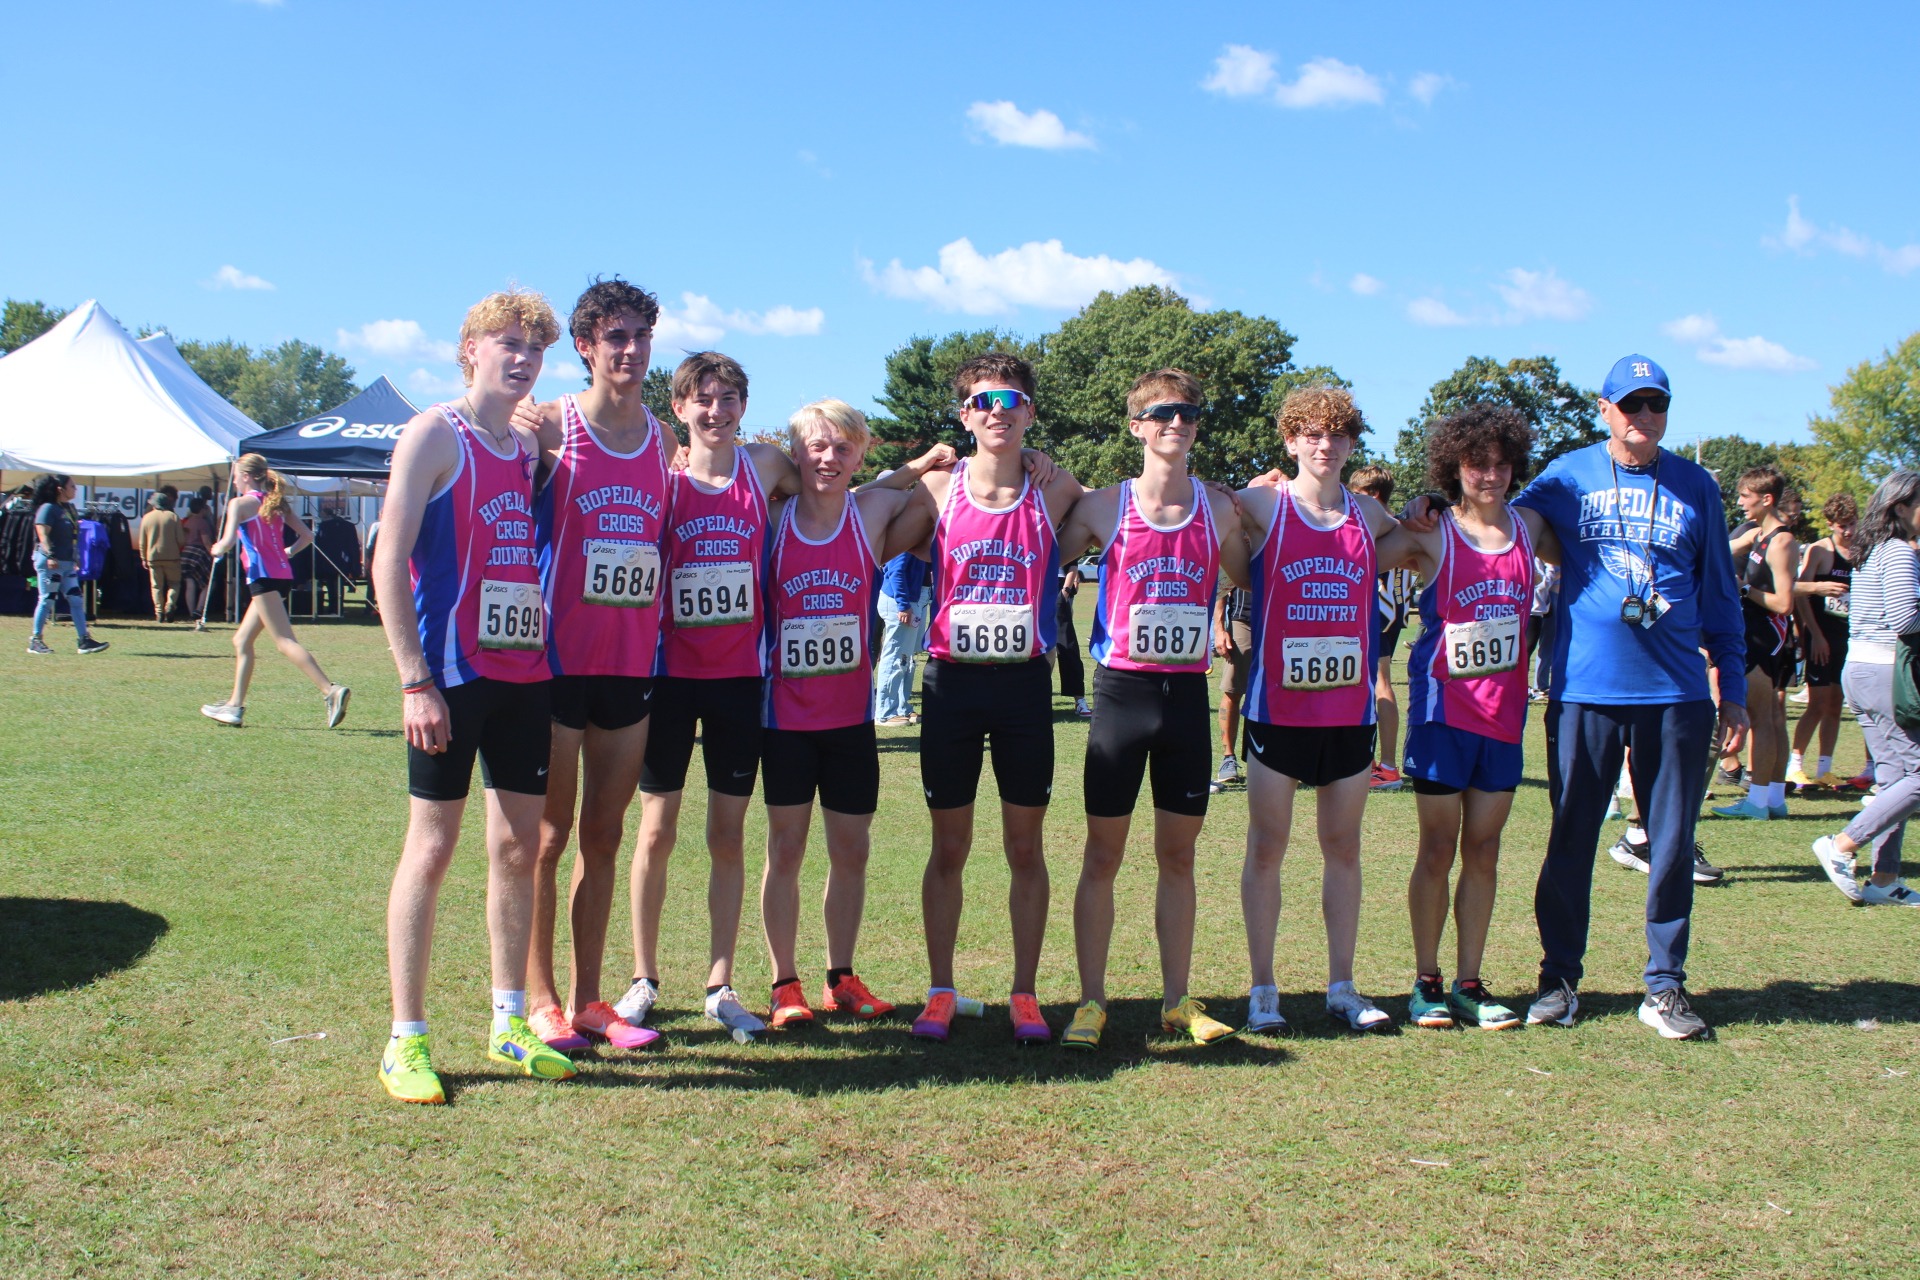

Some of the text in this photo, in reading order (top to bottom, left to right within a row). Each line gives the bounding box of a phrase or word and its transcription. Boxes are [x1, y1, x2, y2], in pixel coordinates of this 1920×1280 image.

[341, 423, 406, 440] asic
[478, 491, 533, 526] HOEA
[575, 485, 660, 520] HOPEDALE
[1578, 487, 1684, 532] HOPEDALE
[496, 520, 529, 540] CROS
[598, 513, 644, 534] CROSS
[675, 515, 756, 543] HOPEDALE
[1580, 523, 1679, 546] ATHLETCS
[695, 539, 739, 557] CROSS
[950, 539, 1037, 569] HOPEDALE
[592, 564, 656, 597] 5684
[782, 569, 862, 598] HOPEDALE
[968, 563, 1015, 582] CROSS
[1125, 556, 1205, 584] HOPEDALE
[1281, 556, 1365, 585] HOPEDALE
[679, 584, 749, 617] 5694
[802, 593, 844, 611] CROSS
[955, 585, 1027, 605] COUNTRY
[1145, 581, 1188, 598] CROSS
[1301, 582, 1349, 599] CROSS
[1287, 604, 1358, 622] COUNTRY
[1474, 604, 1516, 620] CROSS
[1828, 597, 1850, 613] 623
[487, 603, 541, 639] 5699
[787, 636, 854, 667] 5698
[957, 625, 1027, 652] 5689
[1136, 625, 1202, 654] 5687
[1454, 634, 1516, 669] 5697
[1290, 655, 1356, 684] 5680
